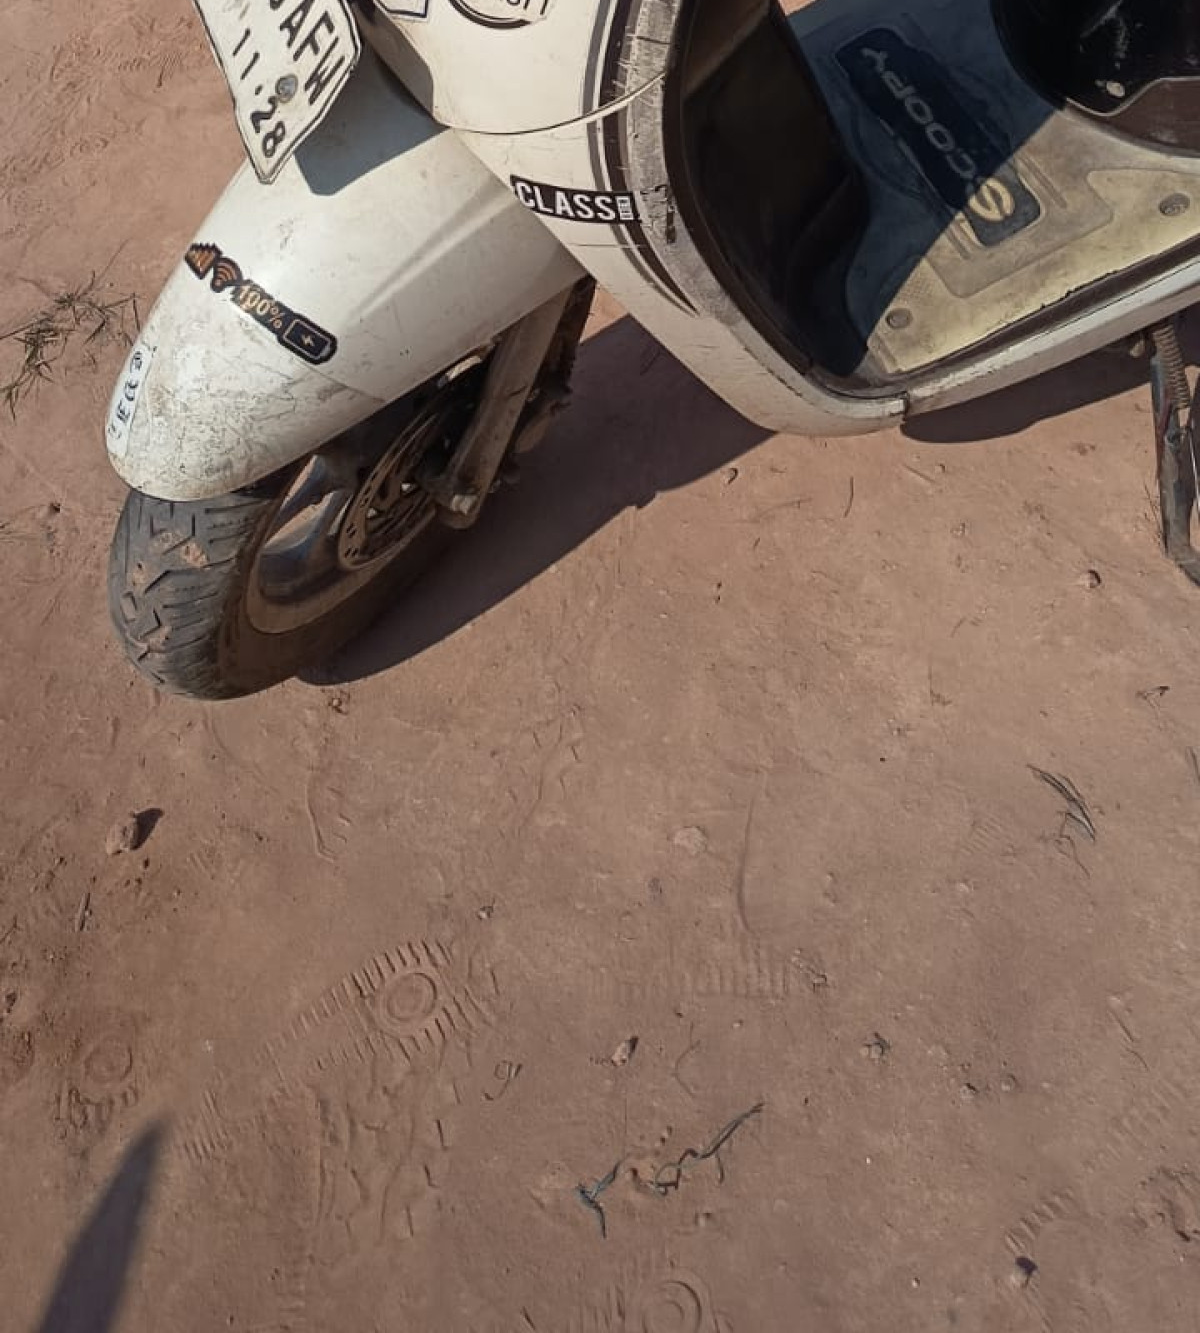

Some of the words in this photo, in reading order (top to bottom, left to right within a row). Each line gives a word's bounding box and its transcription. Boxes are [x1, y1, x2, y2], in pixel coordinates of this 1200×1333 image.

[862, 47, 1017, 222] SCOOPY
[515, 180, 617, 221] CLASS
[239, 285, 286, 330] 100%
